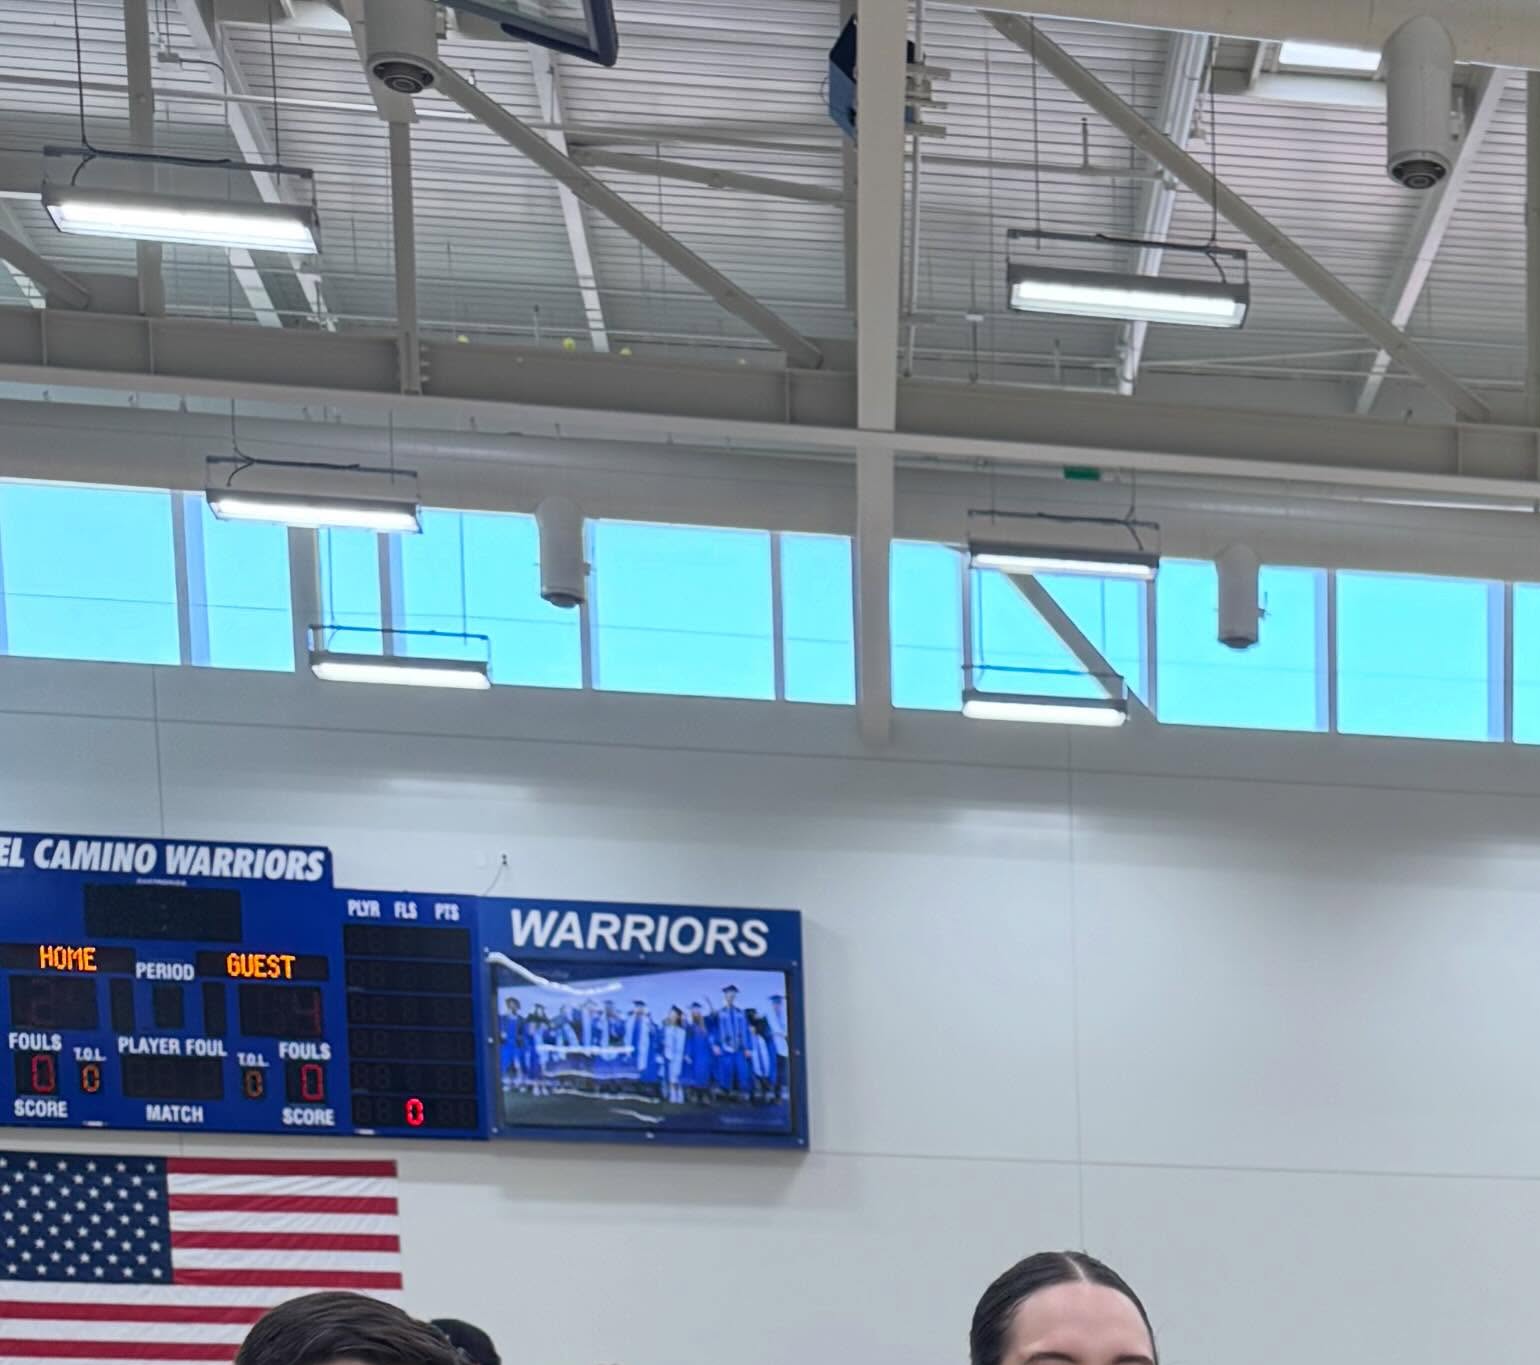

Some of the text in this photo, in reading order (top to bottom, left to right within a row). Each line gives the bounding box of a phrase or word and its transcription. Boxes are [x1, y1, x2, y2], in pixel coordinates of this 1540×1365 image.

[0, 837, 325, 881] EL CAMINO WARRIORS
[347, 899, 460, 921] PLYR FLS PTS
[510, 908, 769, 957] WARRIORS
[39, 945, 97, 971] HOME
[135, 962, 195, 980] PERIOD
[226, 952, 296, 979] GUEST
[8, 1032, 62, 1051] FOULS
[118, 1037, 228, 1057] PLAYER FOUL
[279, 1041, 331, 1060] FOULS
[31, 1054, 56, 1093] 0
[82, 1064, 100, 1093] 0
[245, 1070, 263, 1097] 0
[301, 1063, 324, 1101] 0
[14, 1099, 68, 1118] SCORE
[146, 1104, 204, 1123] MATCH
[282, 1107, 334, 1127] SCORE
[405, 1098, 424, 1126] 0
